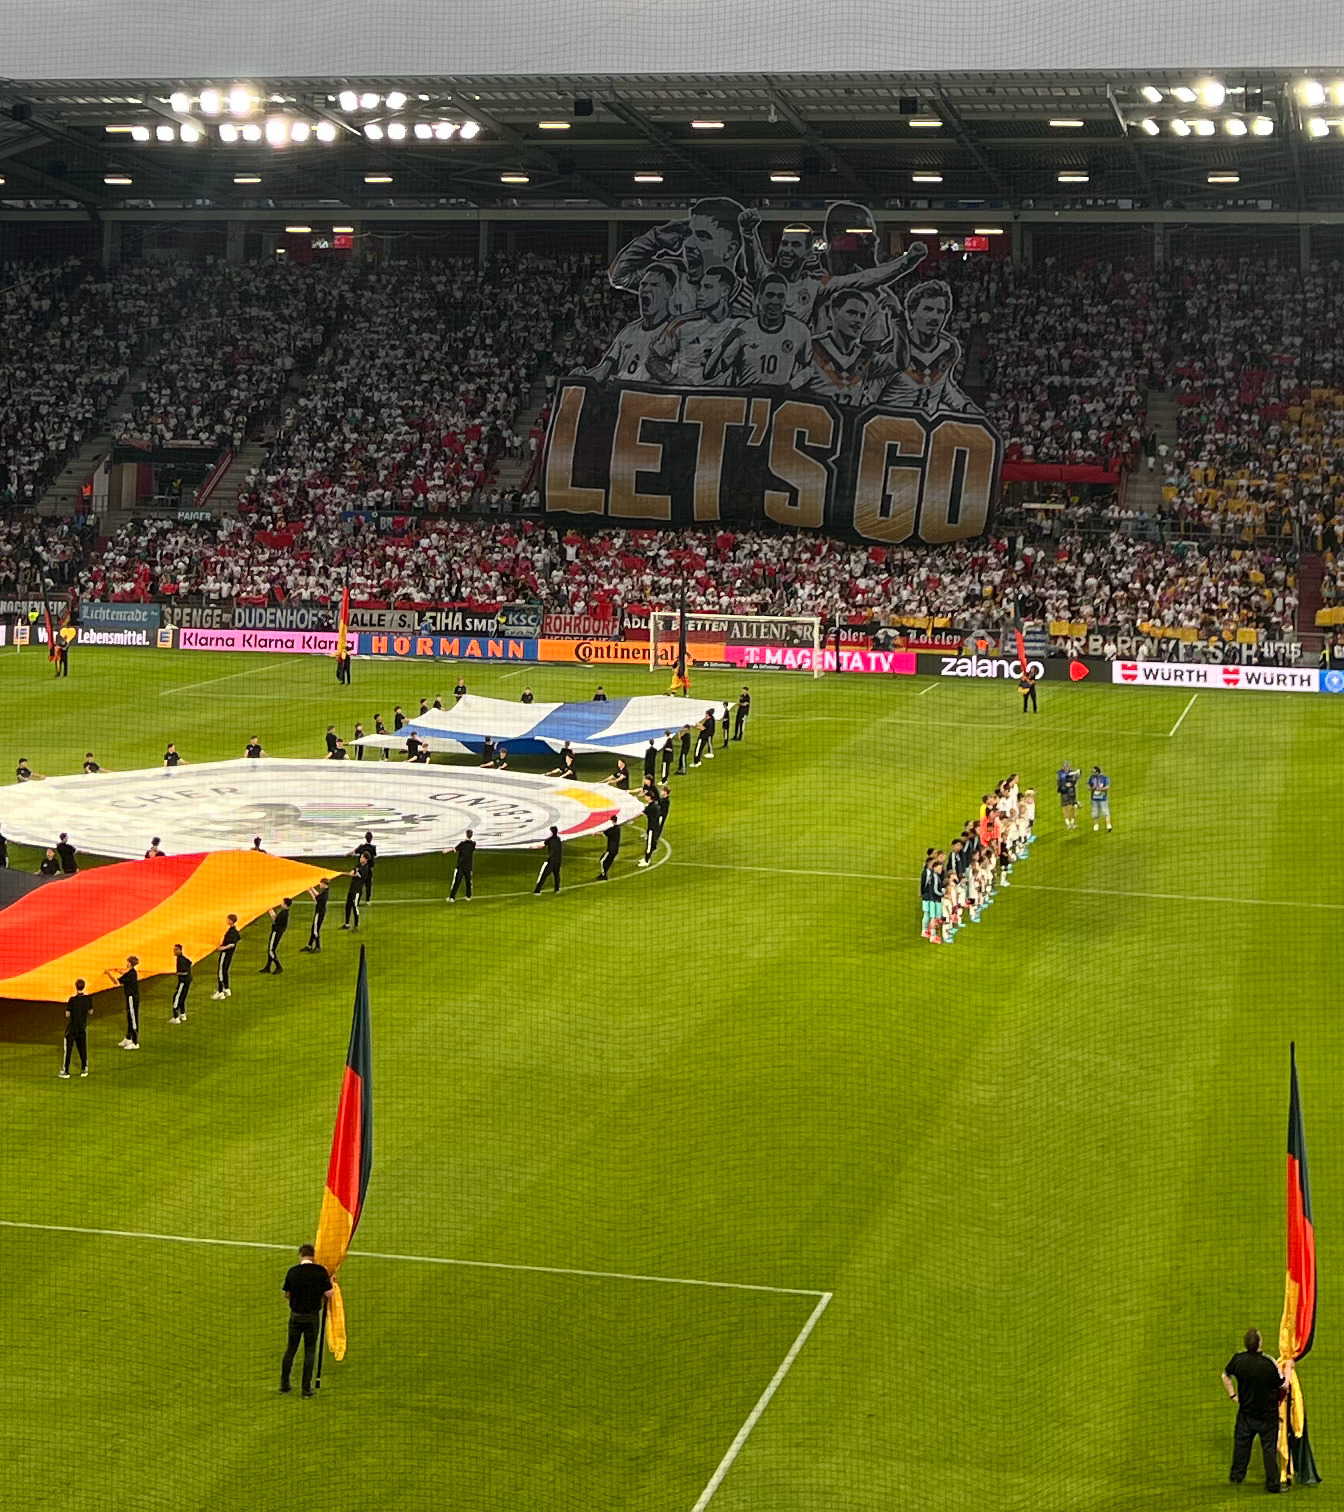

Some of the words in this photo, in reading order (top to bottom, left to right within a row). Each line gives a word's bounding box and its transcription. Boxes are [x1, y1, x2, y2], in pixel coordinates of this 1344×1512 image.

[759, 354, 778, 375] 10
[545, 386, 834, 528] LET'S
[853, 414, 996, 544] GO
[163, 607, 222, 628] SPENGE
[348, 612, 386, 629] ALLE
[623, 617, 664, 630] ADLR
[671, 619, 728, 632] BETTEN
[38, 626, 58, 642] Wr
[183, 632, 235, 648] Klarna
[242, 634, 295, 650] Klarna
[371, 635, 525, 659] HÖRMANN
[574, 641, 674, 663] Continenal
[765, 648, 864, 671] MAGENTA
[867, 652, 894, 672] TV
[1144, 668, 1208, 683] WÜRTH
[1245, 672, 1312, 688] WÜRTH
